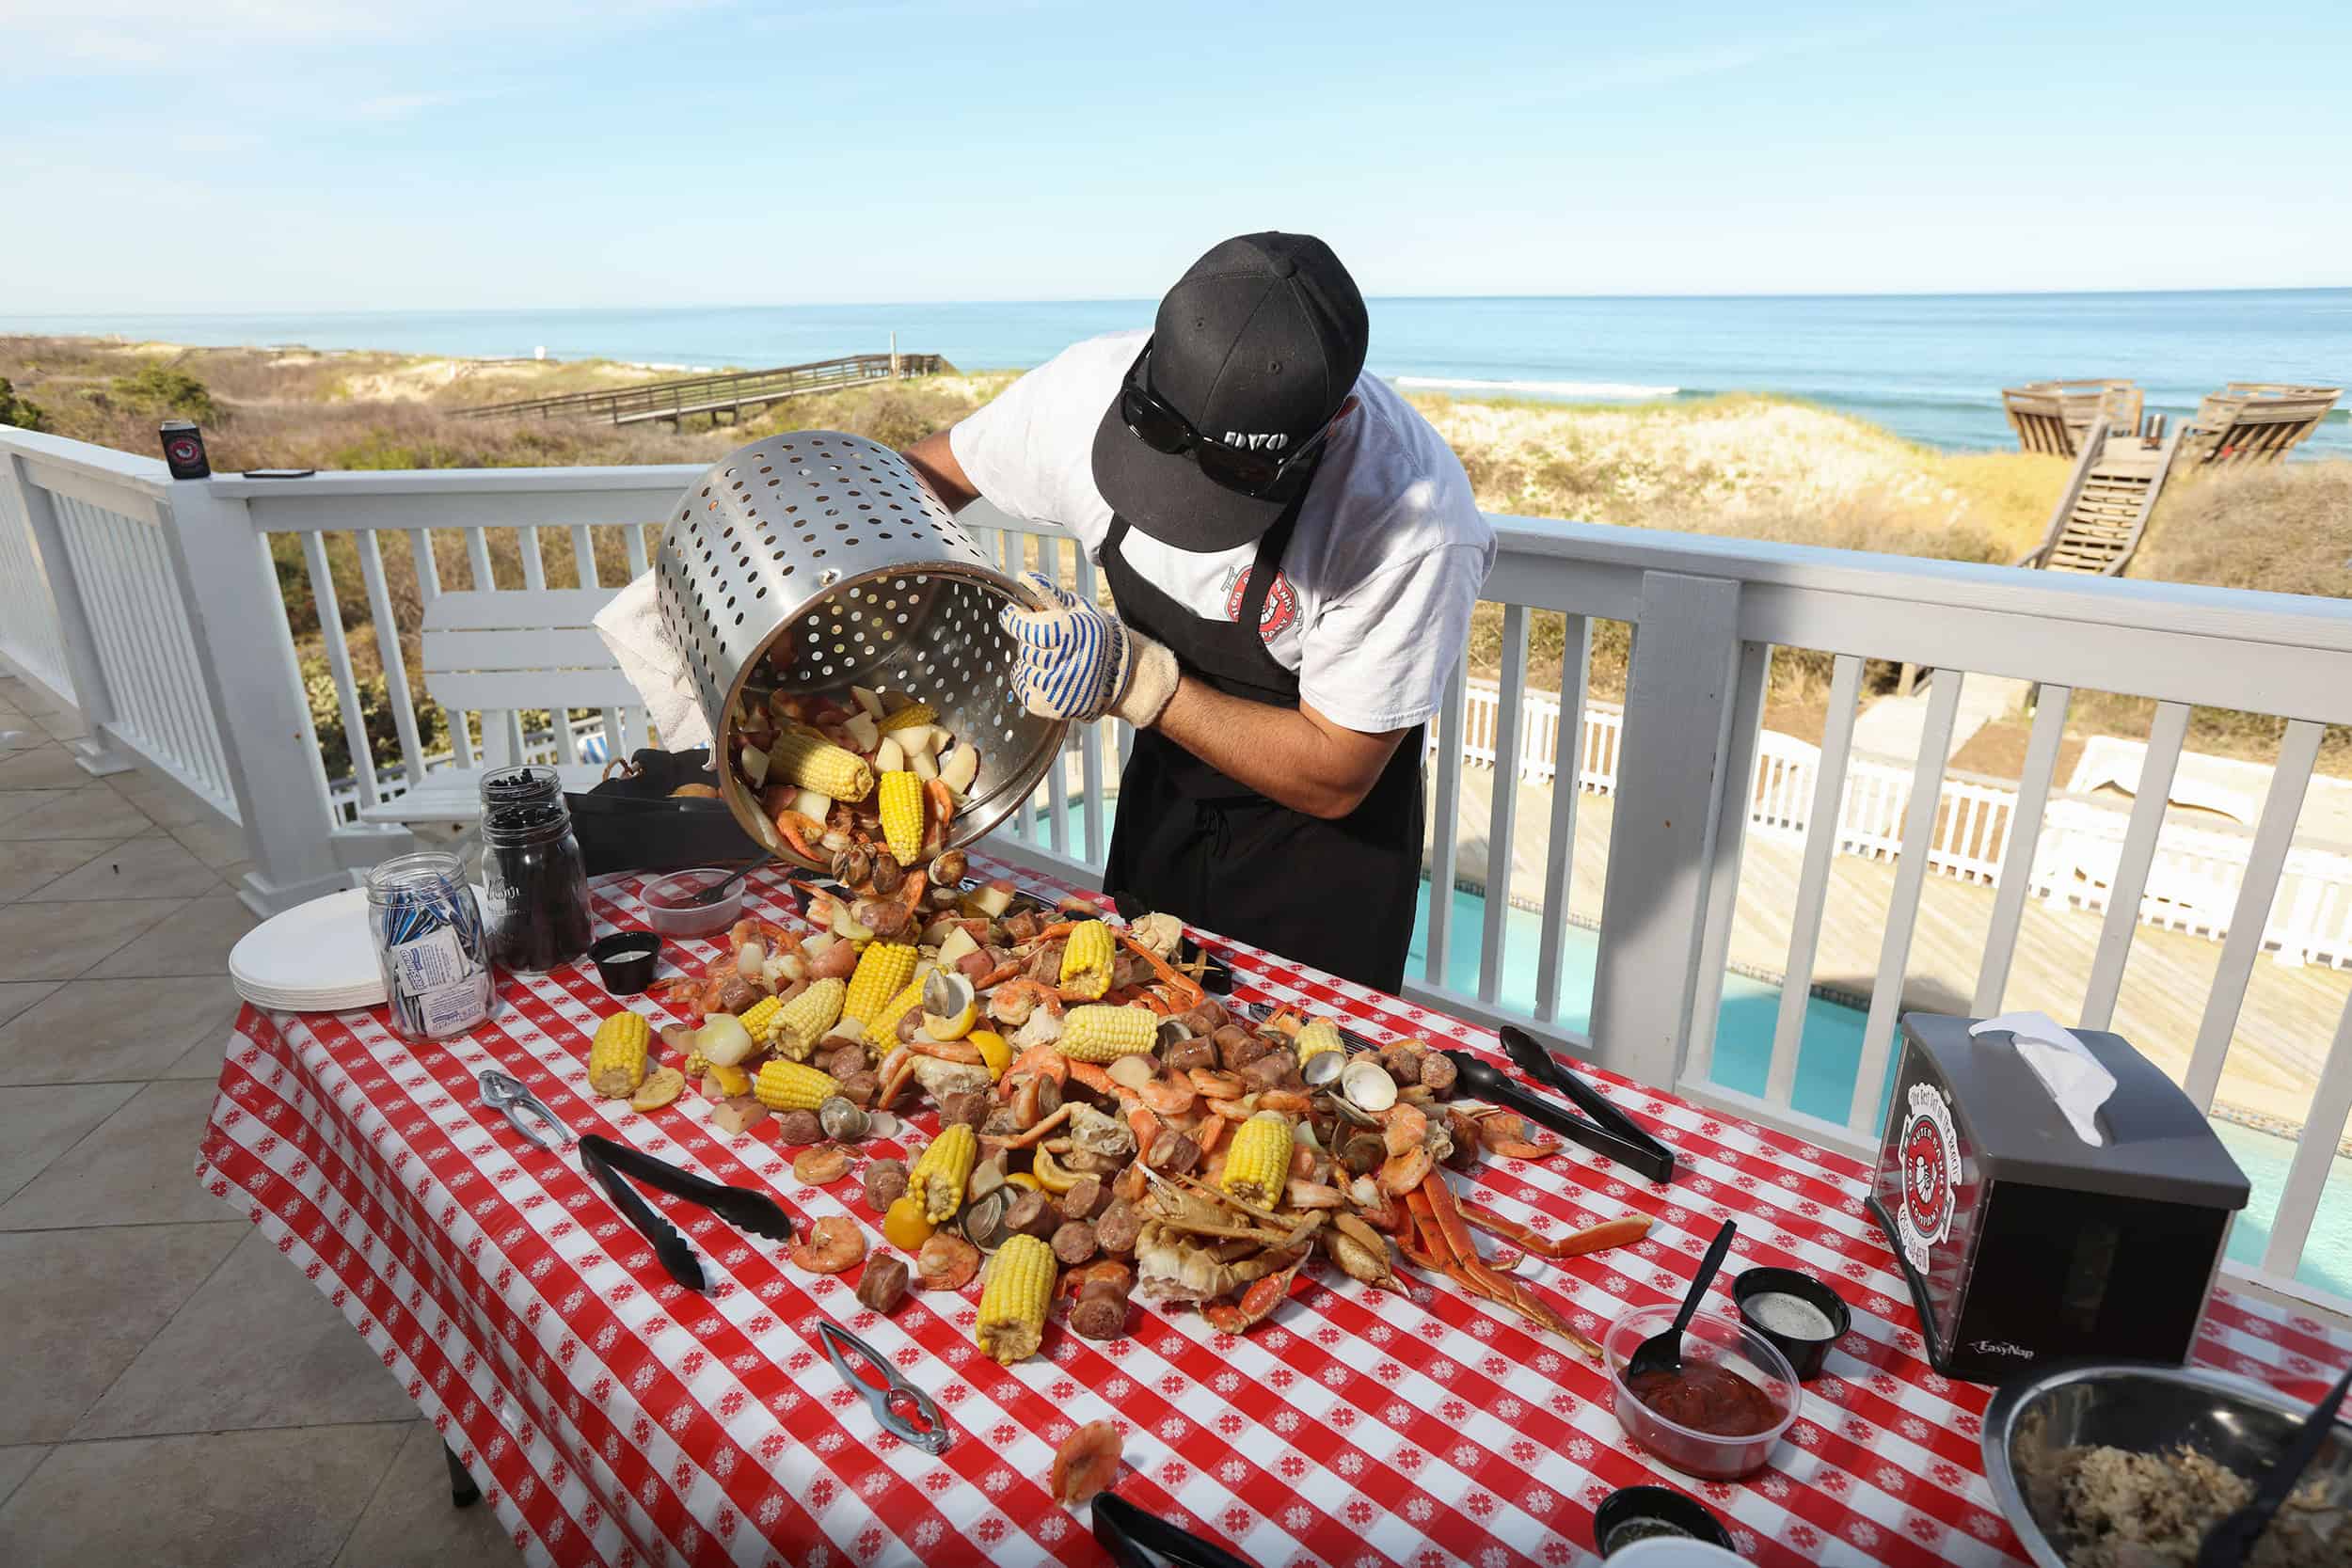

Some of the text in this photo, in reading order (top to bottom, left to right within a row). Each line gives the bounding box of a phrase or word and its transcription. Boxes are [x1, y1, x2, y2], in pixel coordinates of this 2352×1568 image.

[1912, 1127, 1945, 1196] OUTER BANKS
[1911, 1199, 1940, 1227] COMPANY
[1978, 1339, 2035, 1360] EasyNap
